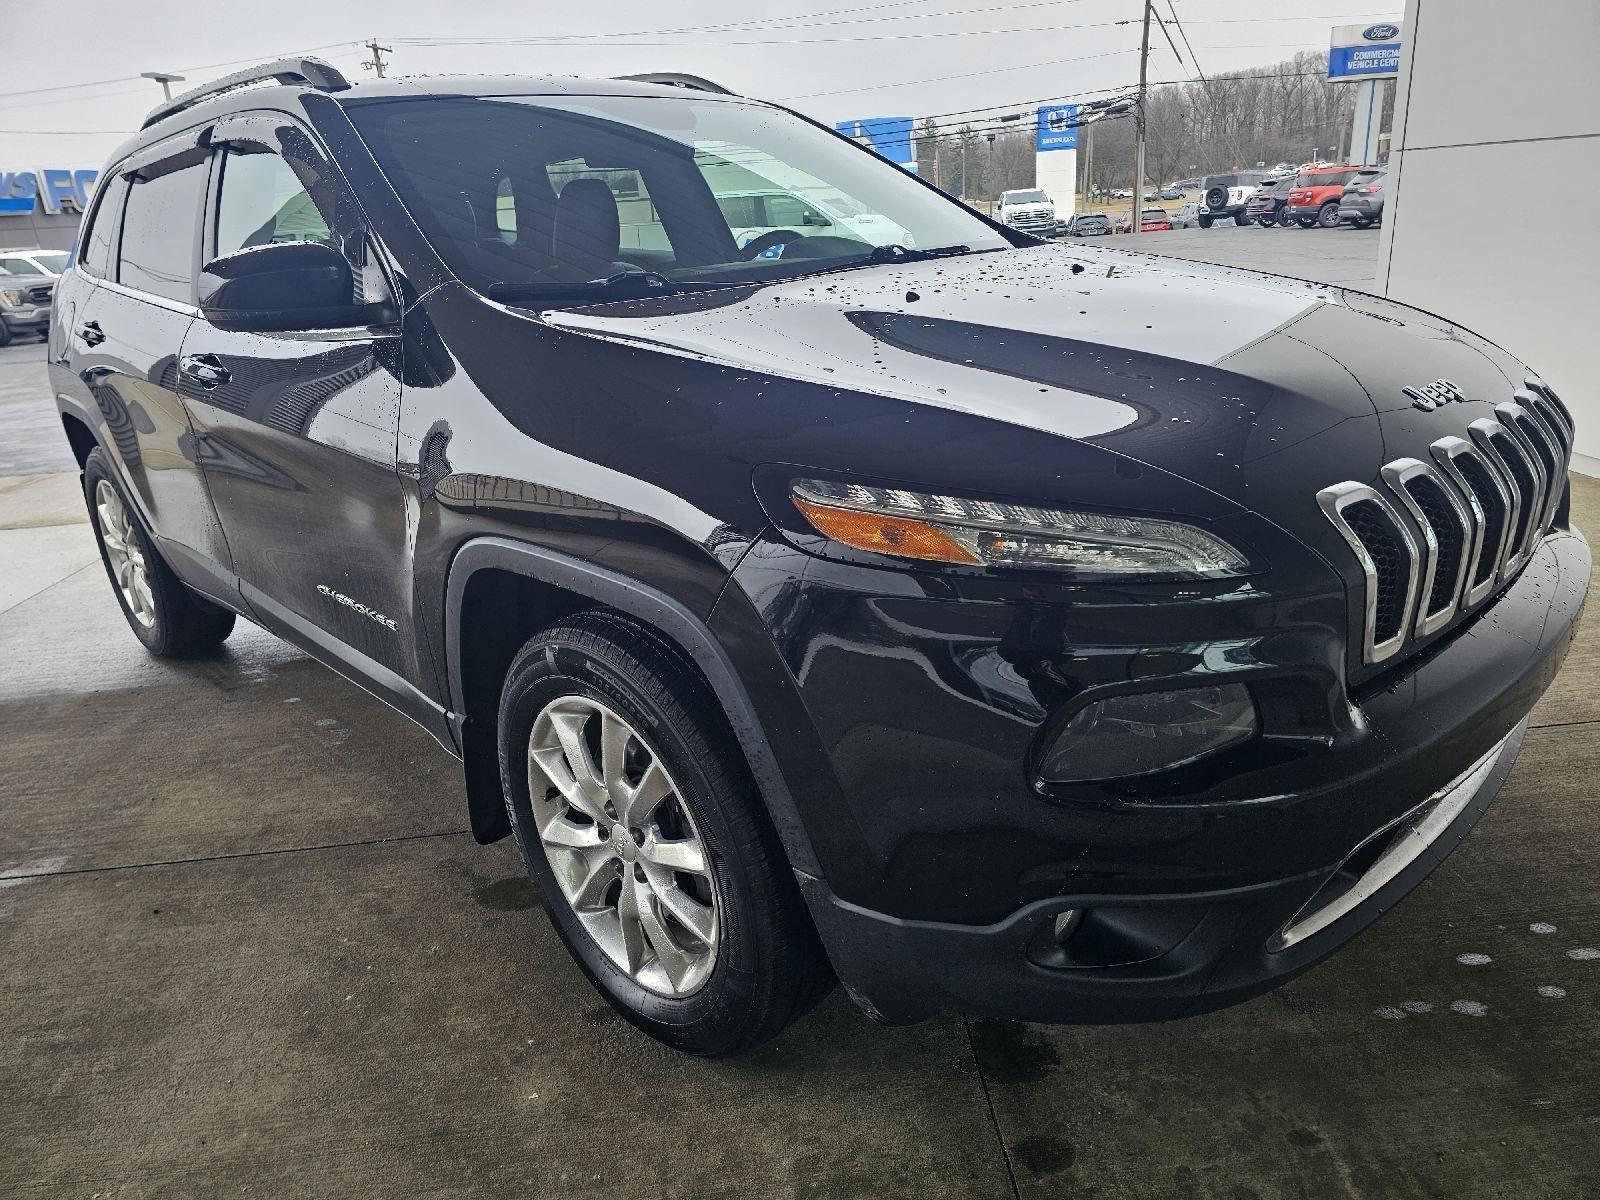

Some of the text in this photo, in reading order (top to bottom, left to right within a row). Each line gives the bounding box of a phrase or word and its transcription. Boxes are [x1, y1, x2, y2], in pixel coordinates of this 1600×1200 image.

[1370, 26, 1394, 38] Ford
[1354, 48, 1400, 61] COMMERCIA
[1347, 60, 1379, 70] VEHICLE
[1041, 136, 1075, 145] HONDA
[1401, 378, 1466, 410] Jeep
[316, 584, 399, 632] CHEROKEE
